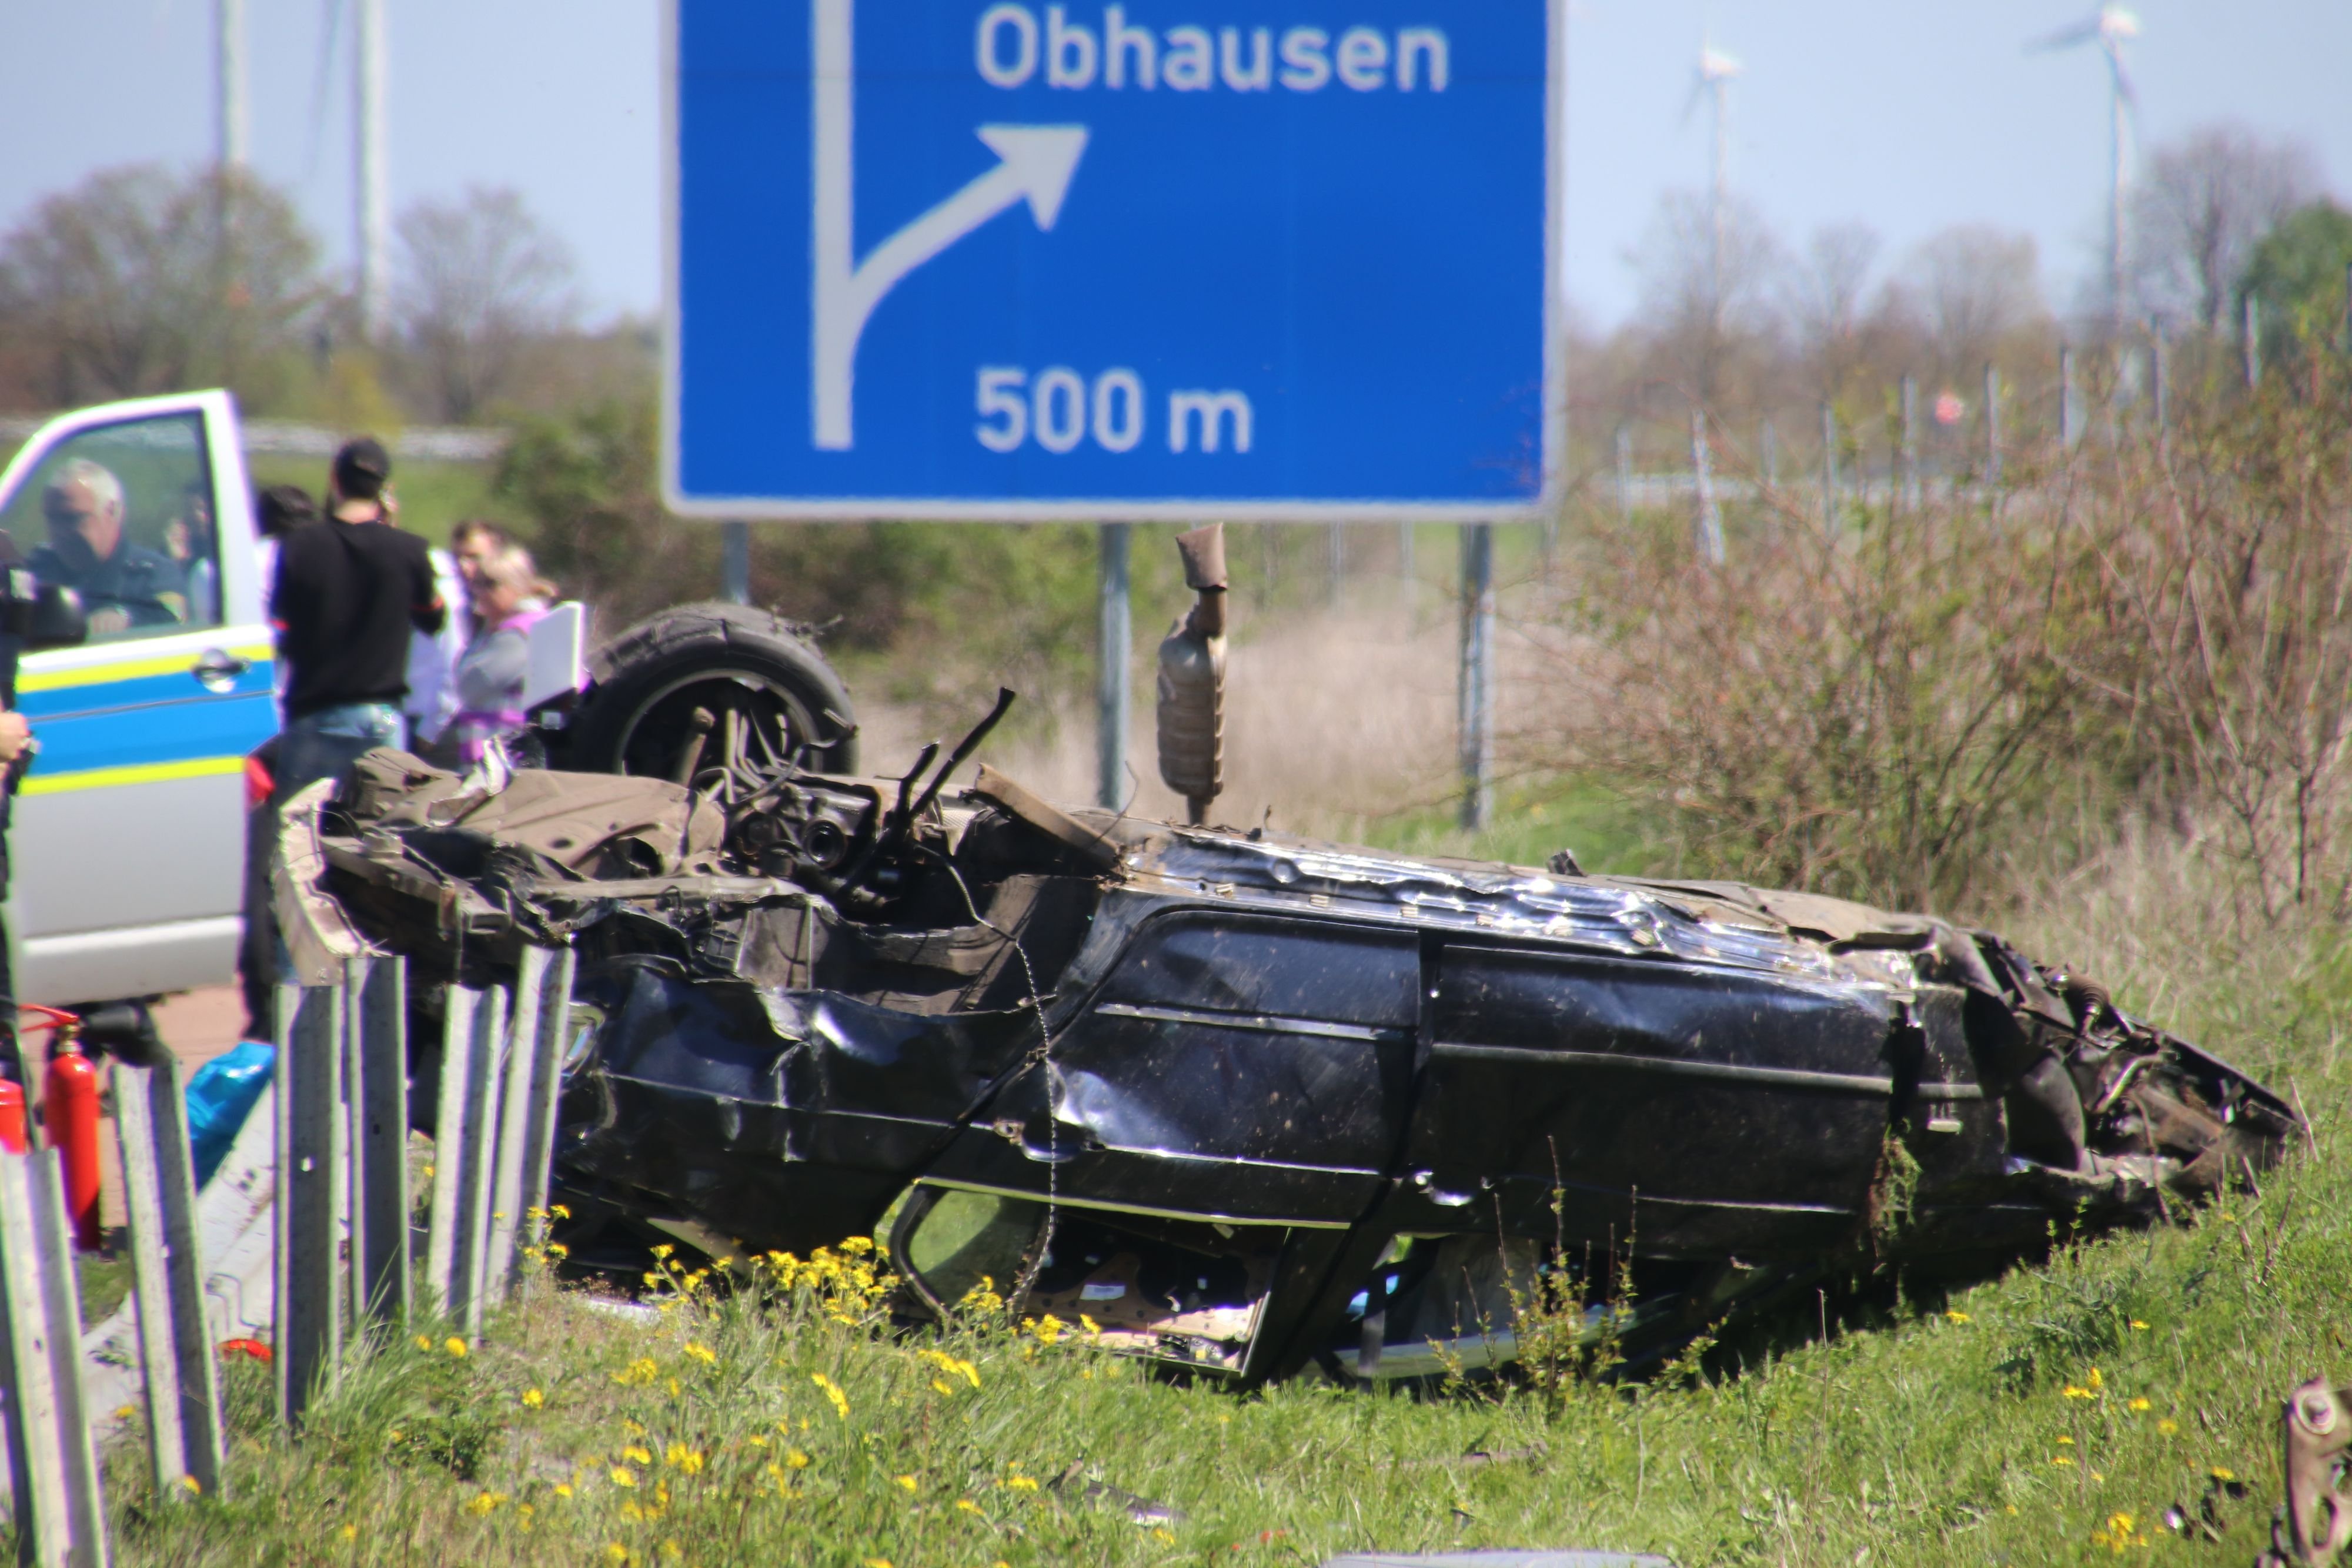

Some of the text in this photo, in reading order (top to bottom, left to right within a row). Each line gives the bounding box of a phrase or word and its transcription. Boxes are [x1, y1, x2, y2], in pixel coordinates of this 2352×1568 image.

[977, 5, 1446, 91] Obhausen
[978, 369, 1251, 452] 500 m
